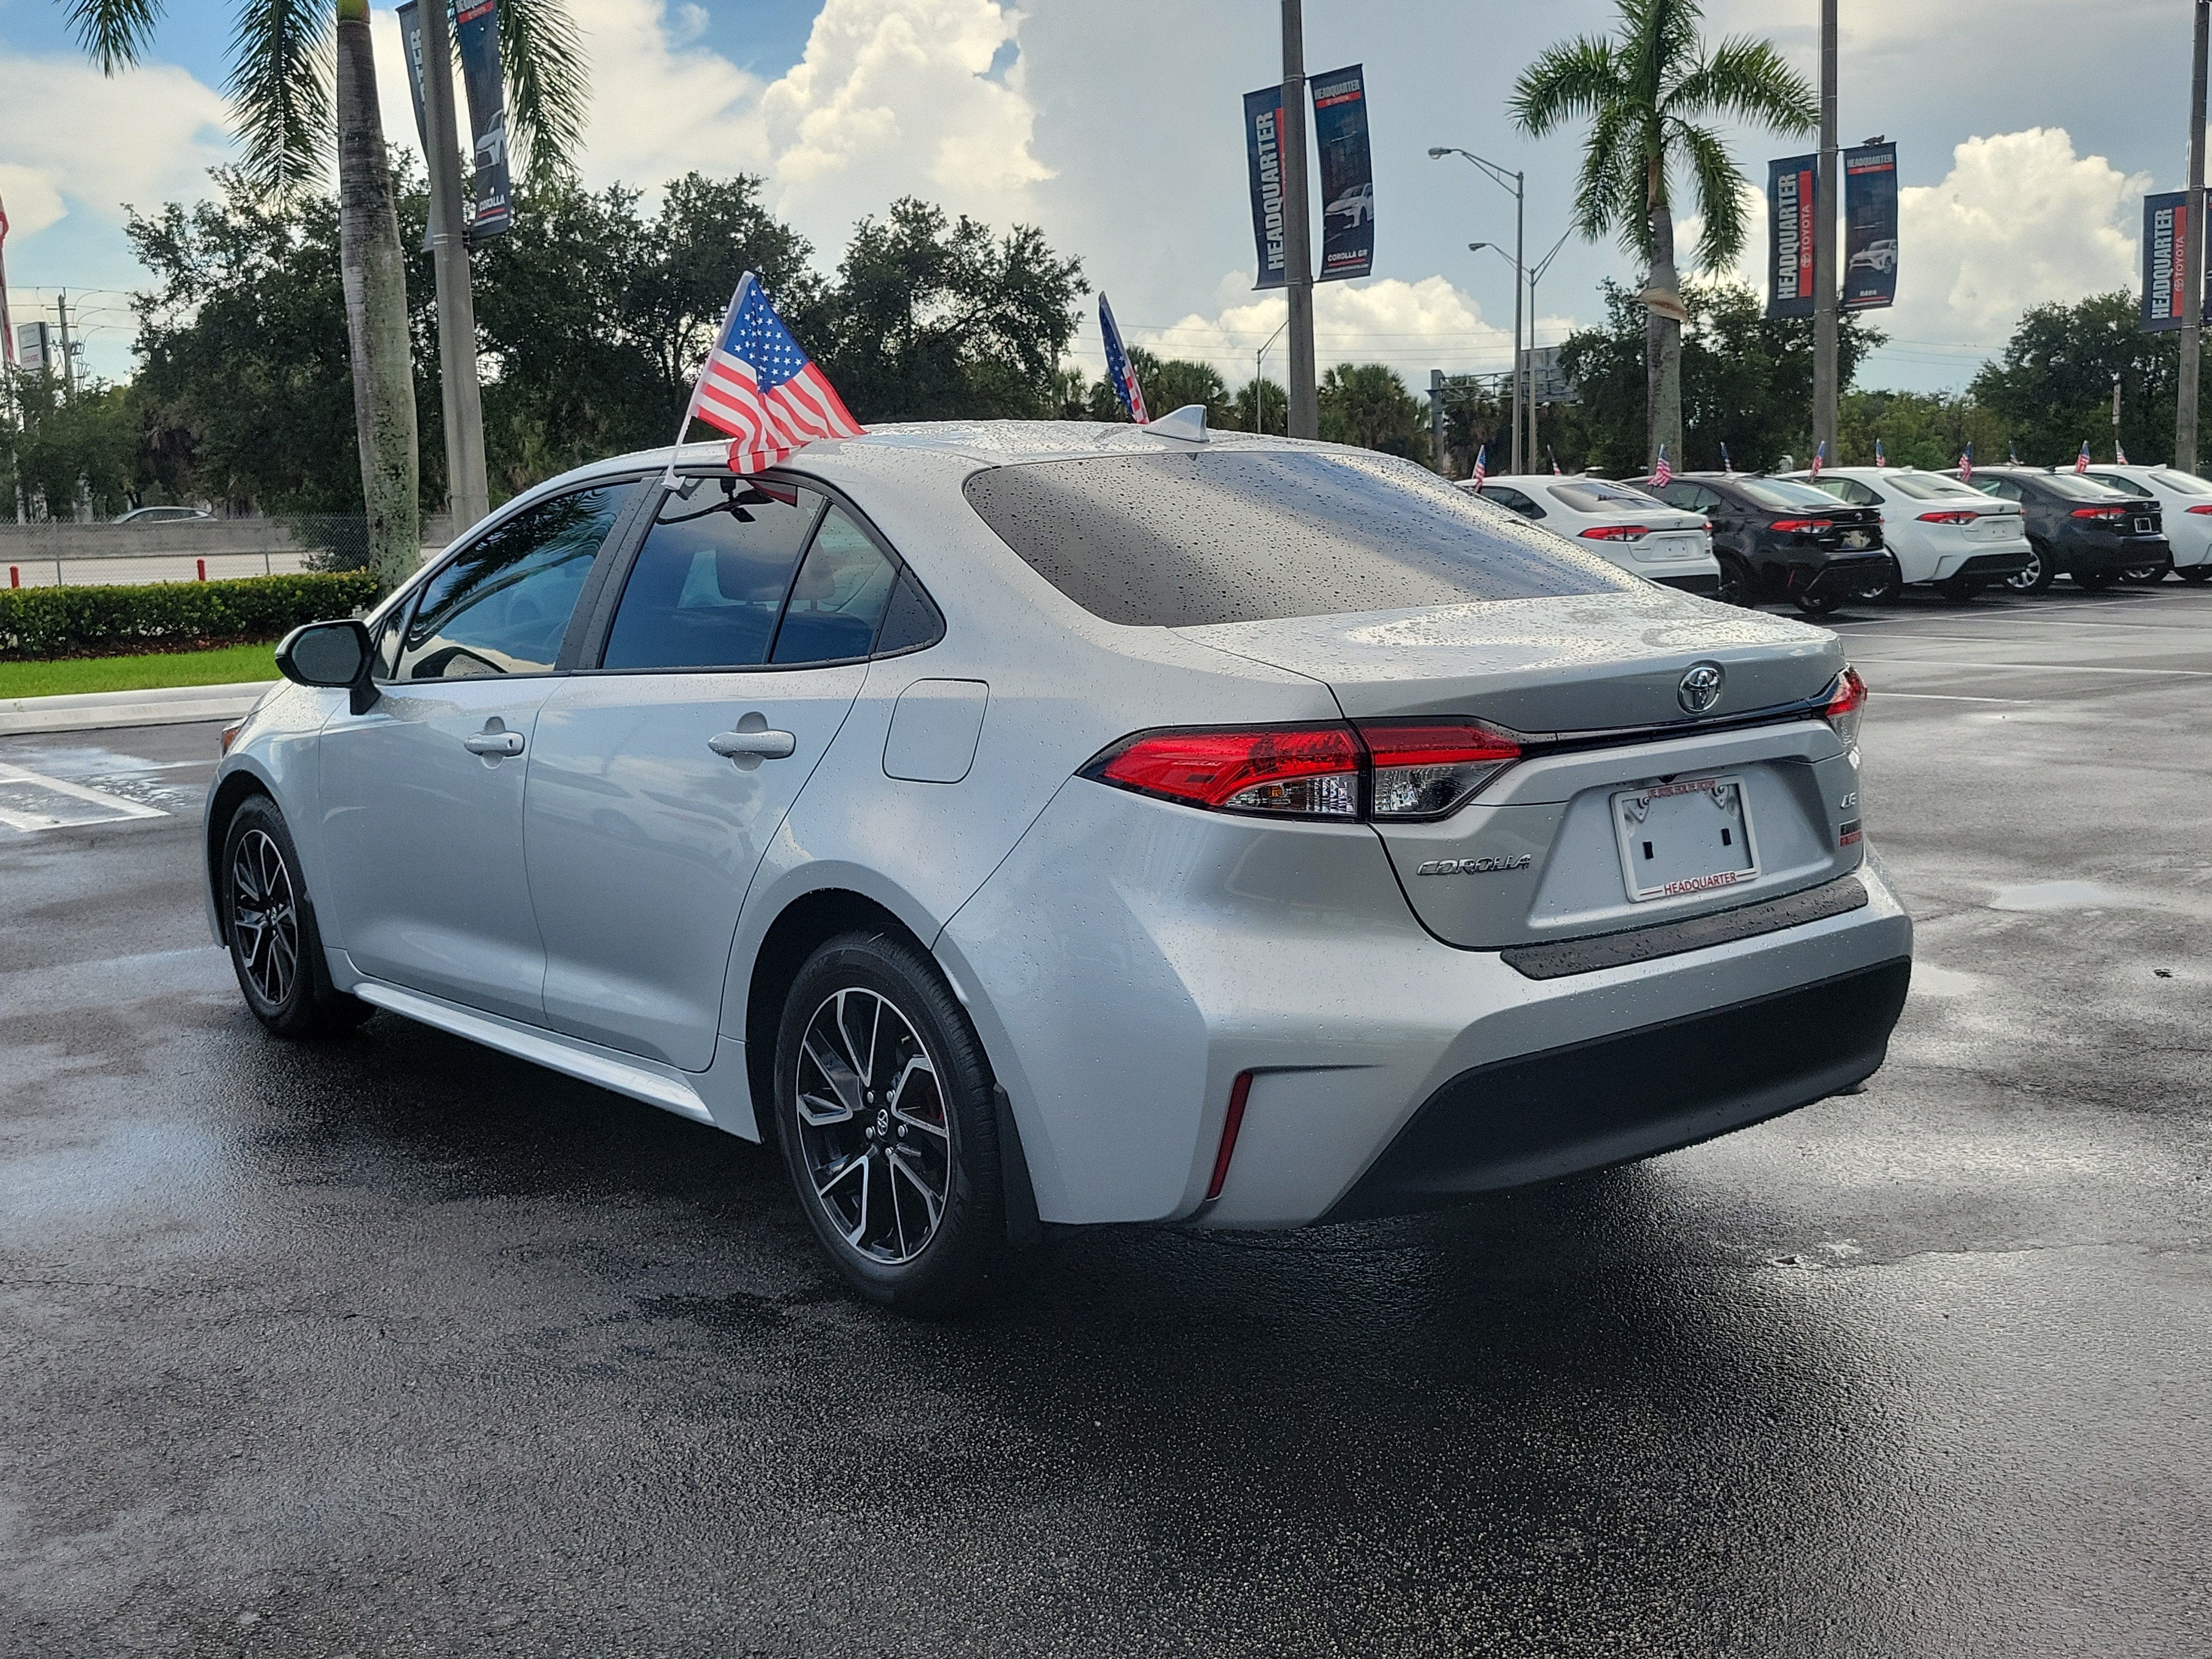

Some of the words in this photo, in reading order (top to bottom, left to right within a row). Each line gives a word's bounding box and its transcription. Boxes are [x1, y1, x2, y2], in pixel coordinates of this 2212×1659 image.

[479, 194, 505, 212] COROLLA
[1256, 111, 1285, 270] HEADQUARTER
[1778, 173, 1799, 300] HEADQUARTER
[1802, 204, 1810, 251] TOYOTA
[1328, 251, 1357, 262] COROLLA
[2151, 208, 2174, 319] HEADQUARTER
[2175, 235, 2185, 276] TOYOTA
[1841, 792, 1857, 808] LE
[1417, 854, 1531, 876] COROLLA
[1663, 872, 1736, 895] HEADQUARTER
